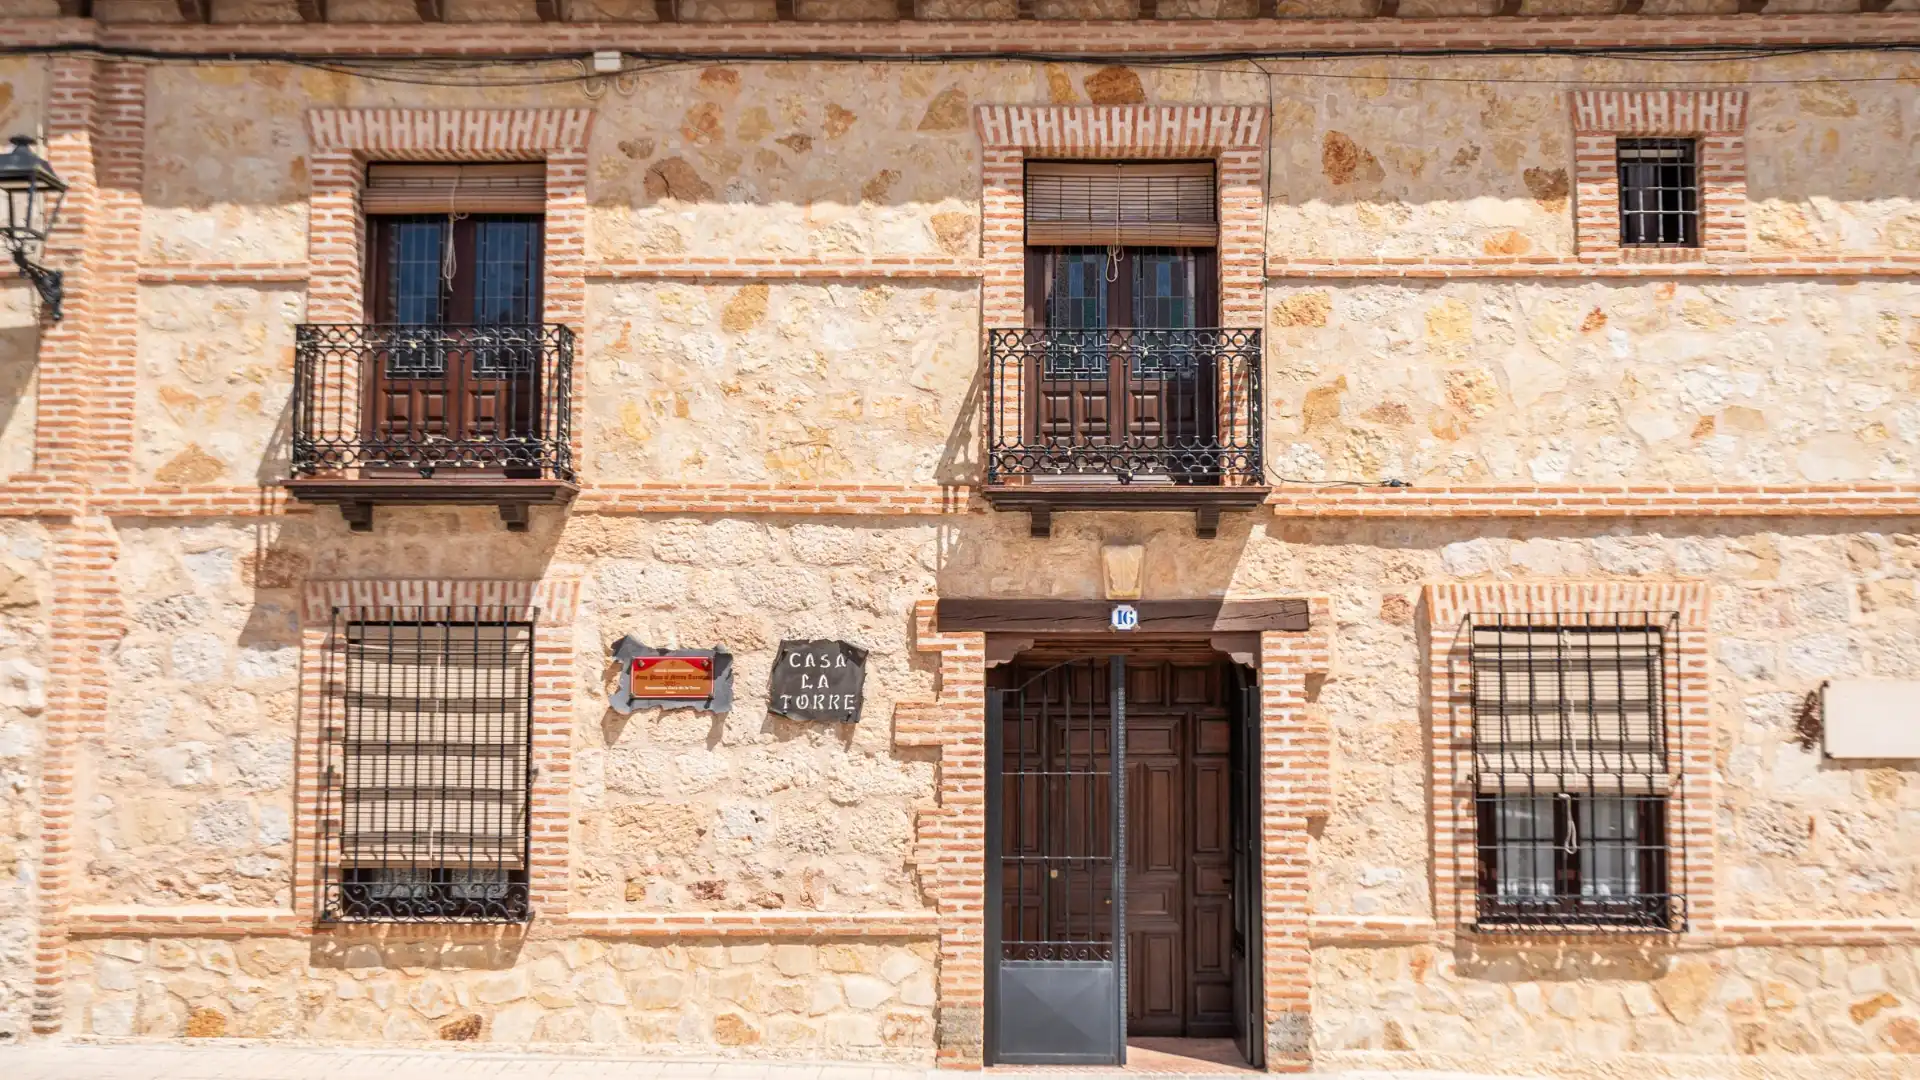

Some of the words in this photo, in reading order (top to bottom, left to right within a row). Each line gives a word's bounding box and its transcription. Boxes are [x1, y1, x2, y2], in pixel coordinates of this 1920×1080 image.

[1117, 610, 1135, 625] 16
[789, 652, 847, 668] CASA
[800, 673, 830, 689] LA
[780, 694, 856, 710] TORRE
